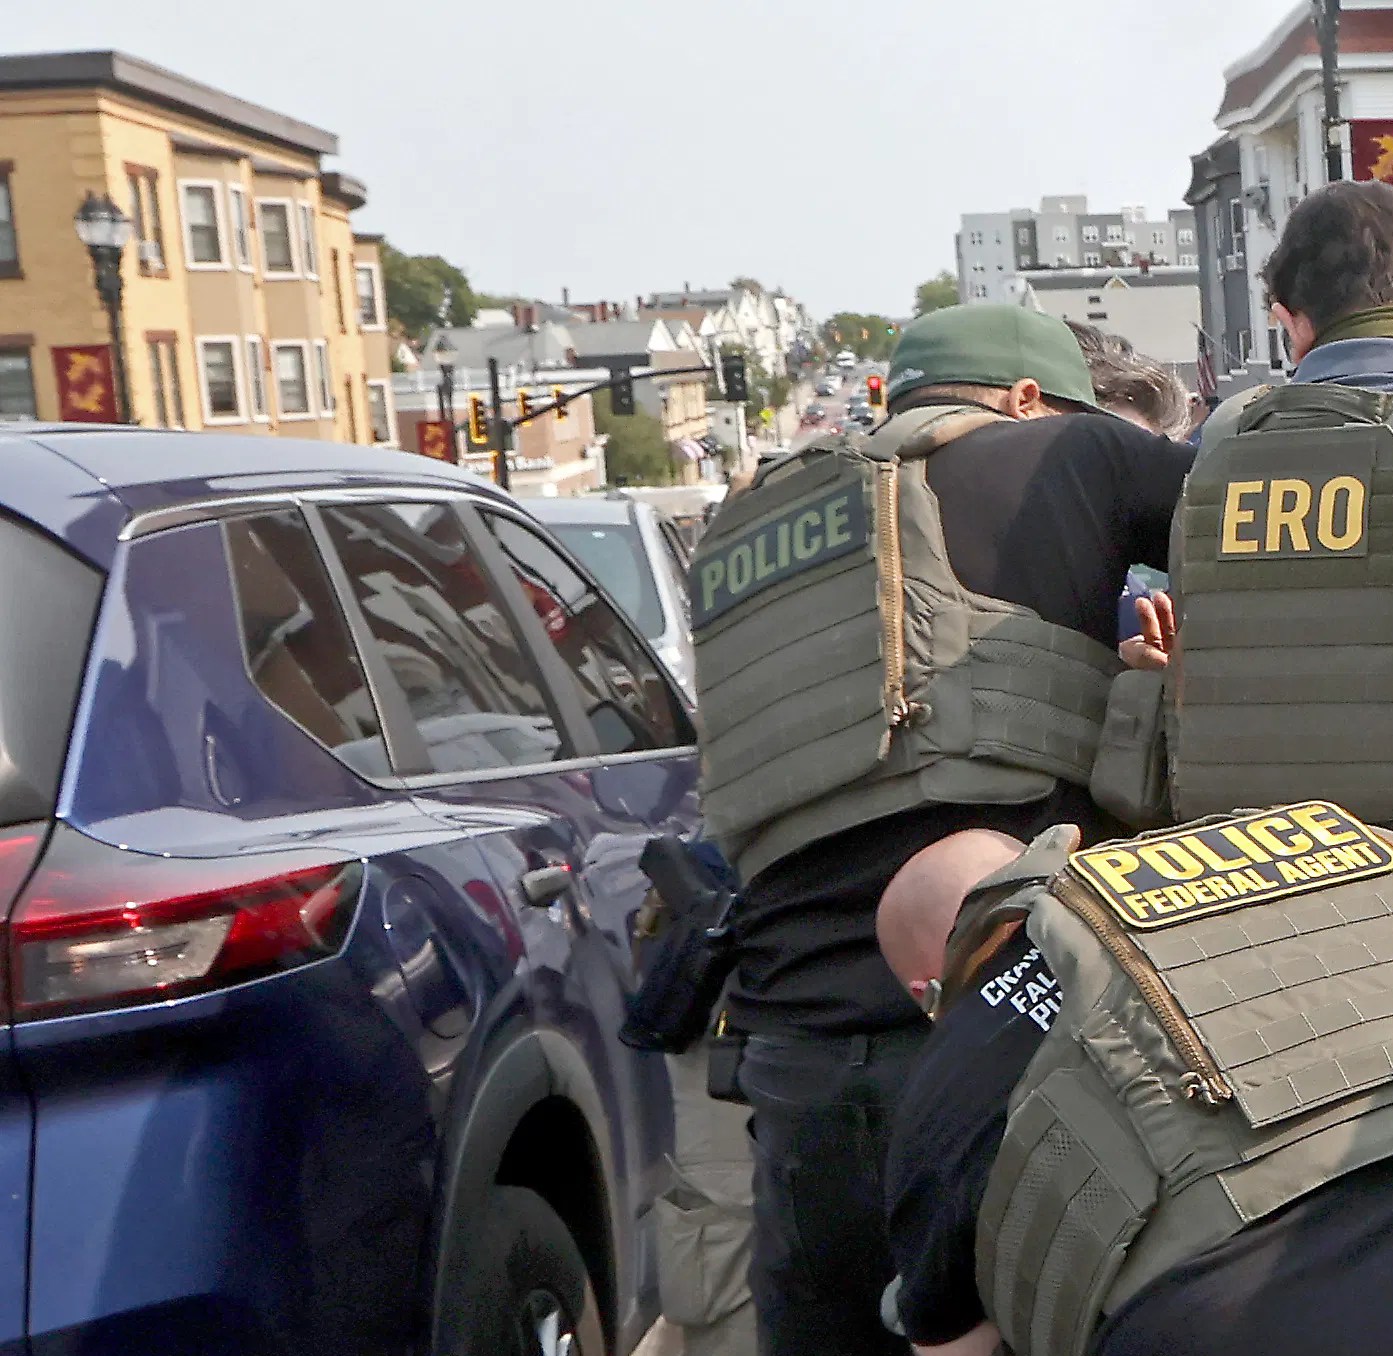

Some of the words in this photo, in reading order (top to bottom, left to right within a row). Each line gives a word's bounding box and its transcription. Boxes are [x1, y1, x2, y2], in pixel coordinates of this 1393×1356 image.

[701, 496, 851, 611] POLICE
[1221, 475, 1366, 554] ERO
[1084, 805, 1362, 894] POLICE
[1122, 868, 1280, 920] FEDERAL
[1274, 842, 1383, 884] AGENT
